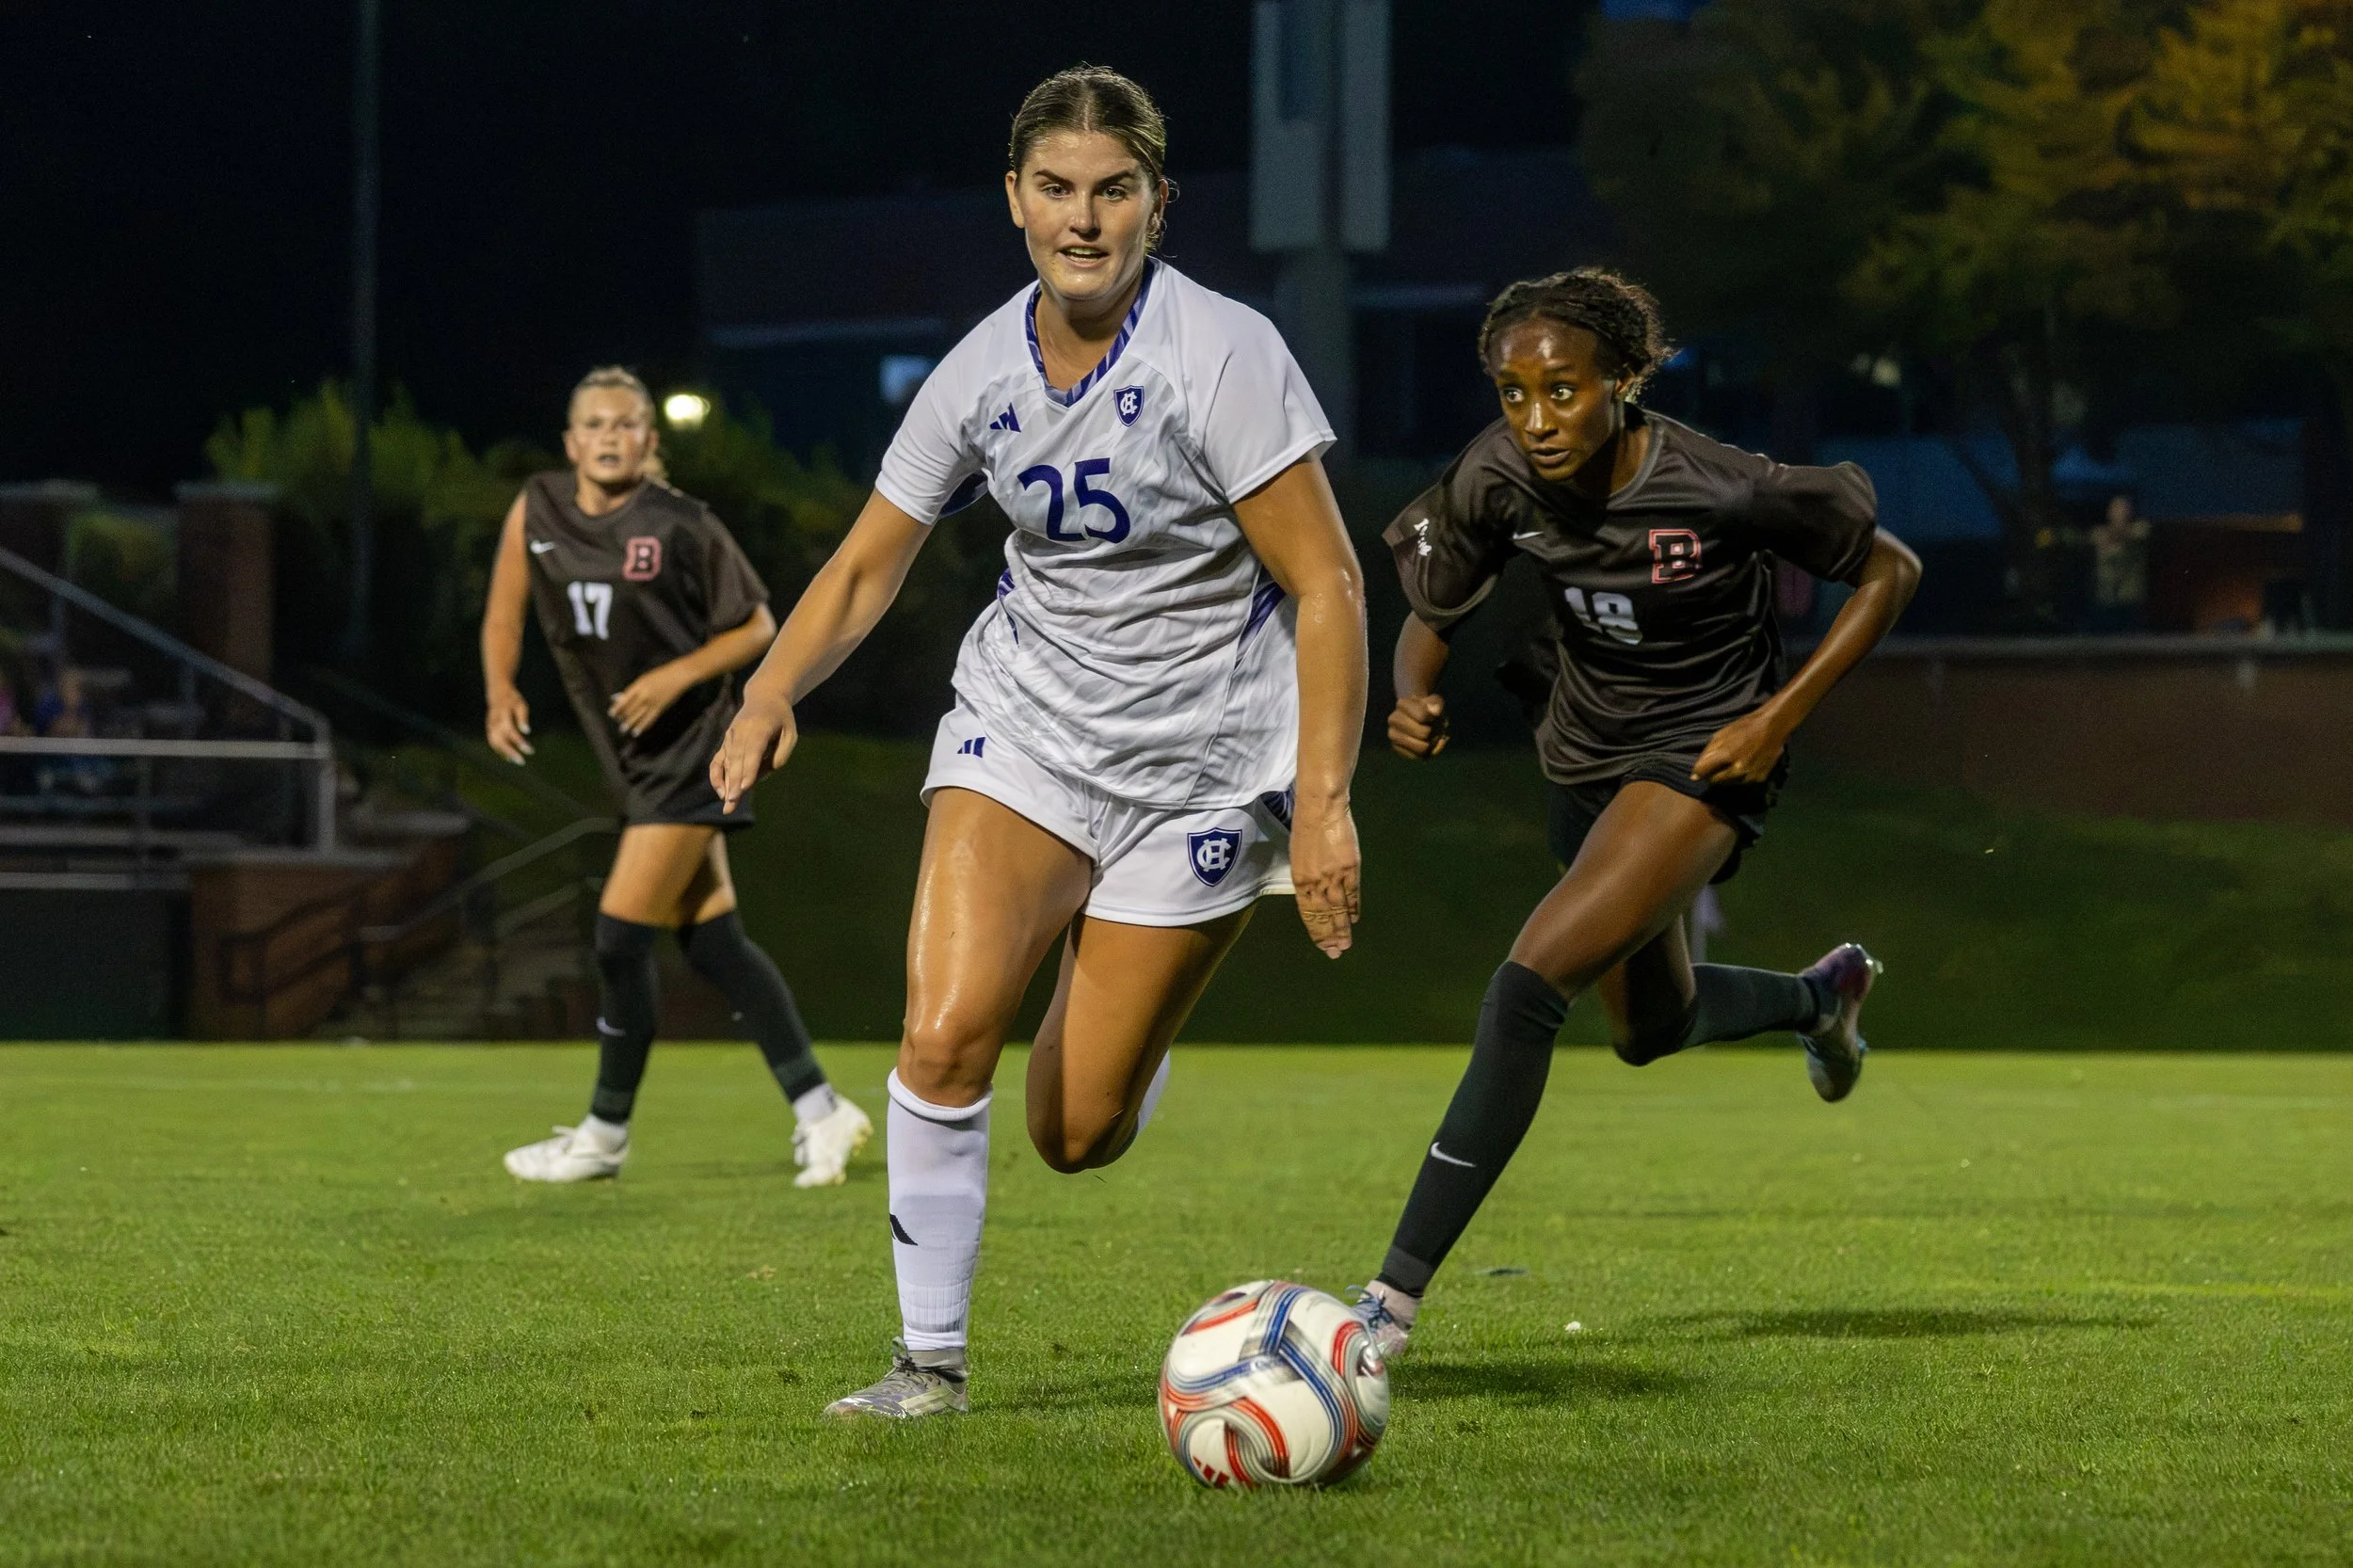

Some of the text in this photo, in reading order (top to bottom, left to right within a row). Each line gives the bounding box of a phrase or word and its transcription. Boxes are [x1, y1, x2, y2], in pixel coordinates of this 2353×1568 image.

[1017, 457, 1131, 544] 25
[622, 536, 662, 582] B
[1649, 528, 1703, 584] B
[567, 581, 613, 641] 17
